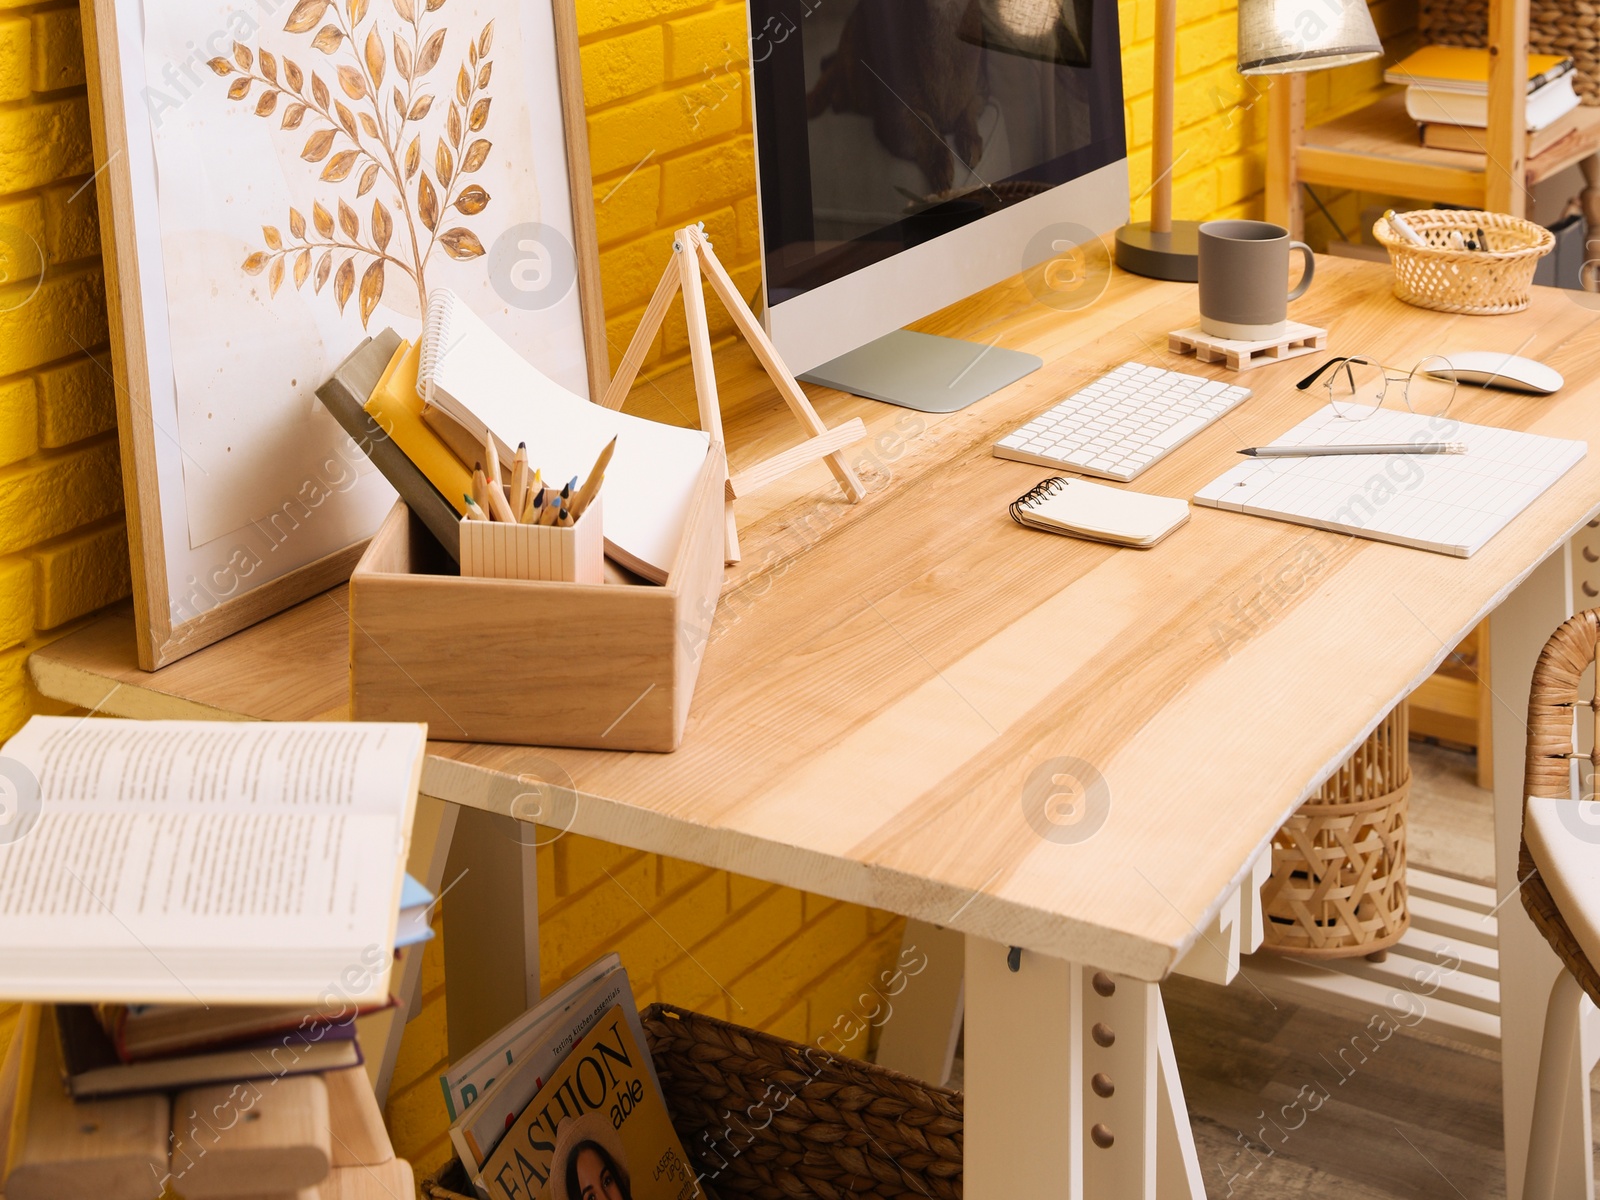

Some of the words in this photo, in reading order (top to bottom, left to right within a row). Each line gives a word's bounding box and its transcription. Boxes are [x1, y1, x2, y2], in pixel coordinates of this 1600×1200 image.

[552, 1034, 574, 1057] Testing
[572, 1013, 594, 1036] kitchen
[593, 987, 621, 1017] essentials
[610, 1078, 644, 1131] able
